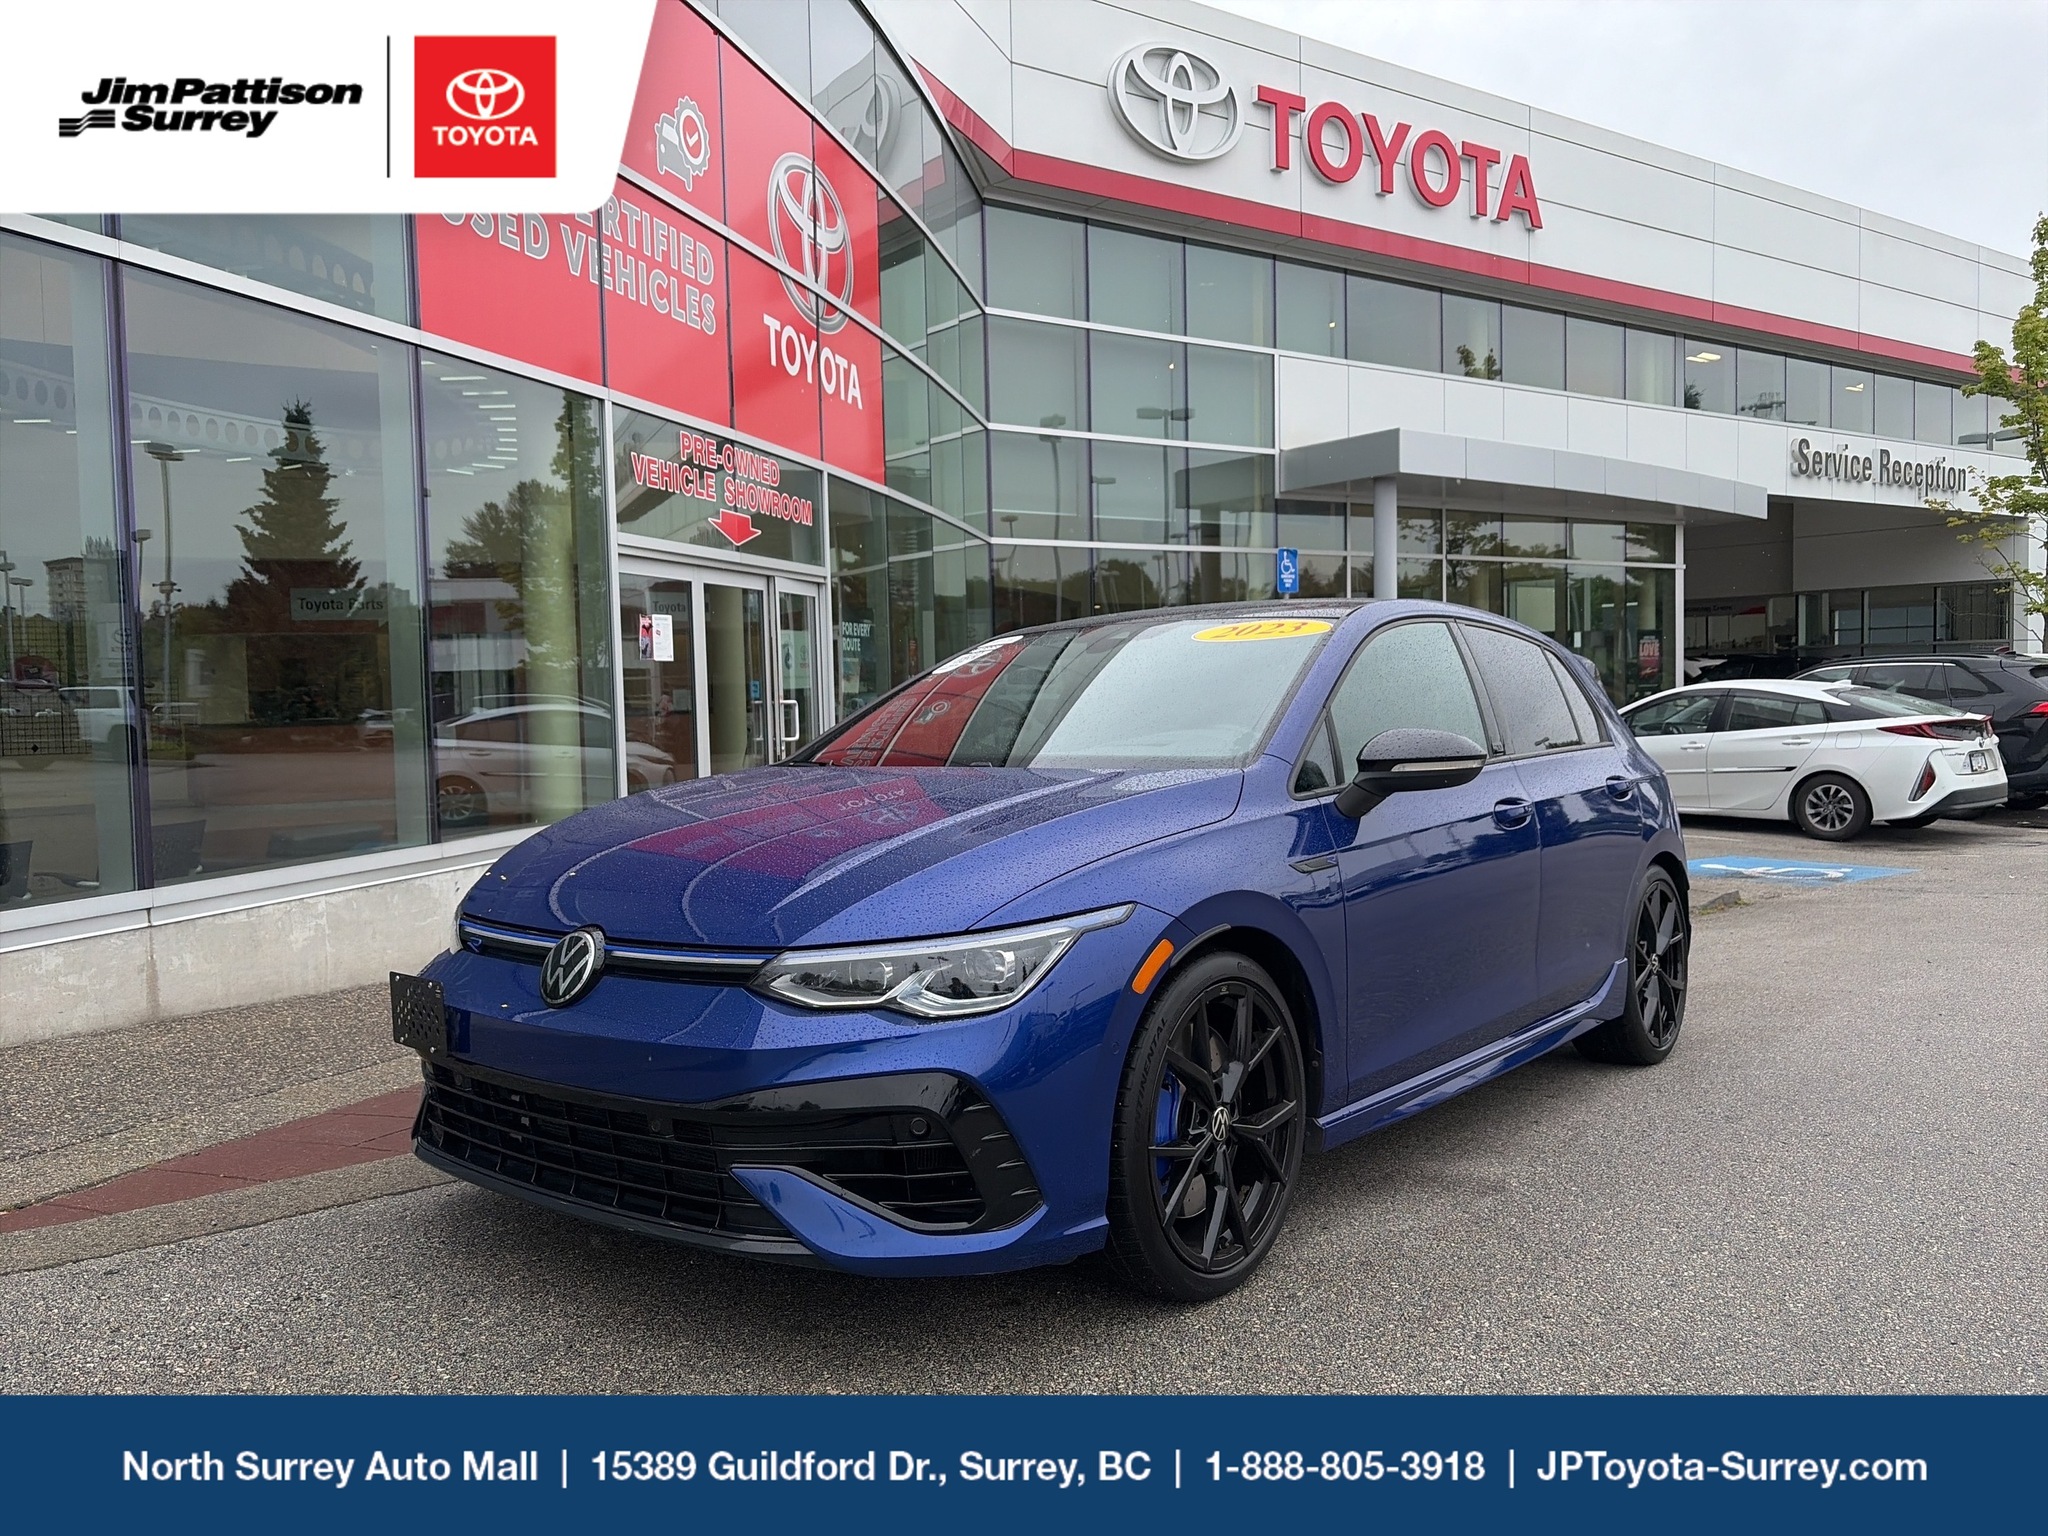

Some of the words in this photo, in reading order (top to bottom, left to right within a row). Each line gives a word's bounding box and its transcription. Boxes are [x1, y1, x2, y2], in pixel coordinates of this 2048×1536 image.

[1254, 84, 1544, 231] TOYOTA
[575, 194, 714, 286] RTIFIED
[560, 222, 716, 335] VEHICLES
[763, 313, 863, 410] TOYOTA
[680, 430, 781, 488] PRE-OWNED
[1794, 438, 1873, 482] Service
[1878, 448, 1967, 498] Reception
[630, 452, 717, 503] VEHICLE
[723, 476, 813, 527] SHOWROOM
[297, 597, 343, 613] Toyota
[854, 622, 872, 637] EVERY
[1209, 621, 1309, 639] 2023
[842, 637, 861, 652] ROUTE
[1640, 642, 1660, 657] LOVE
